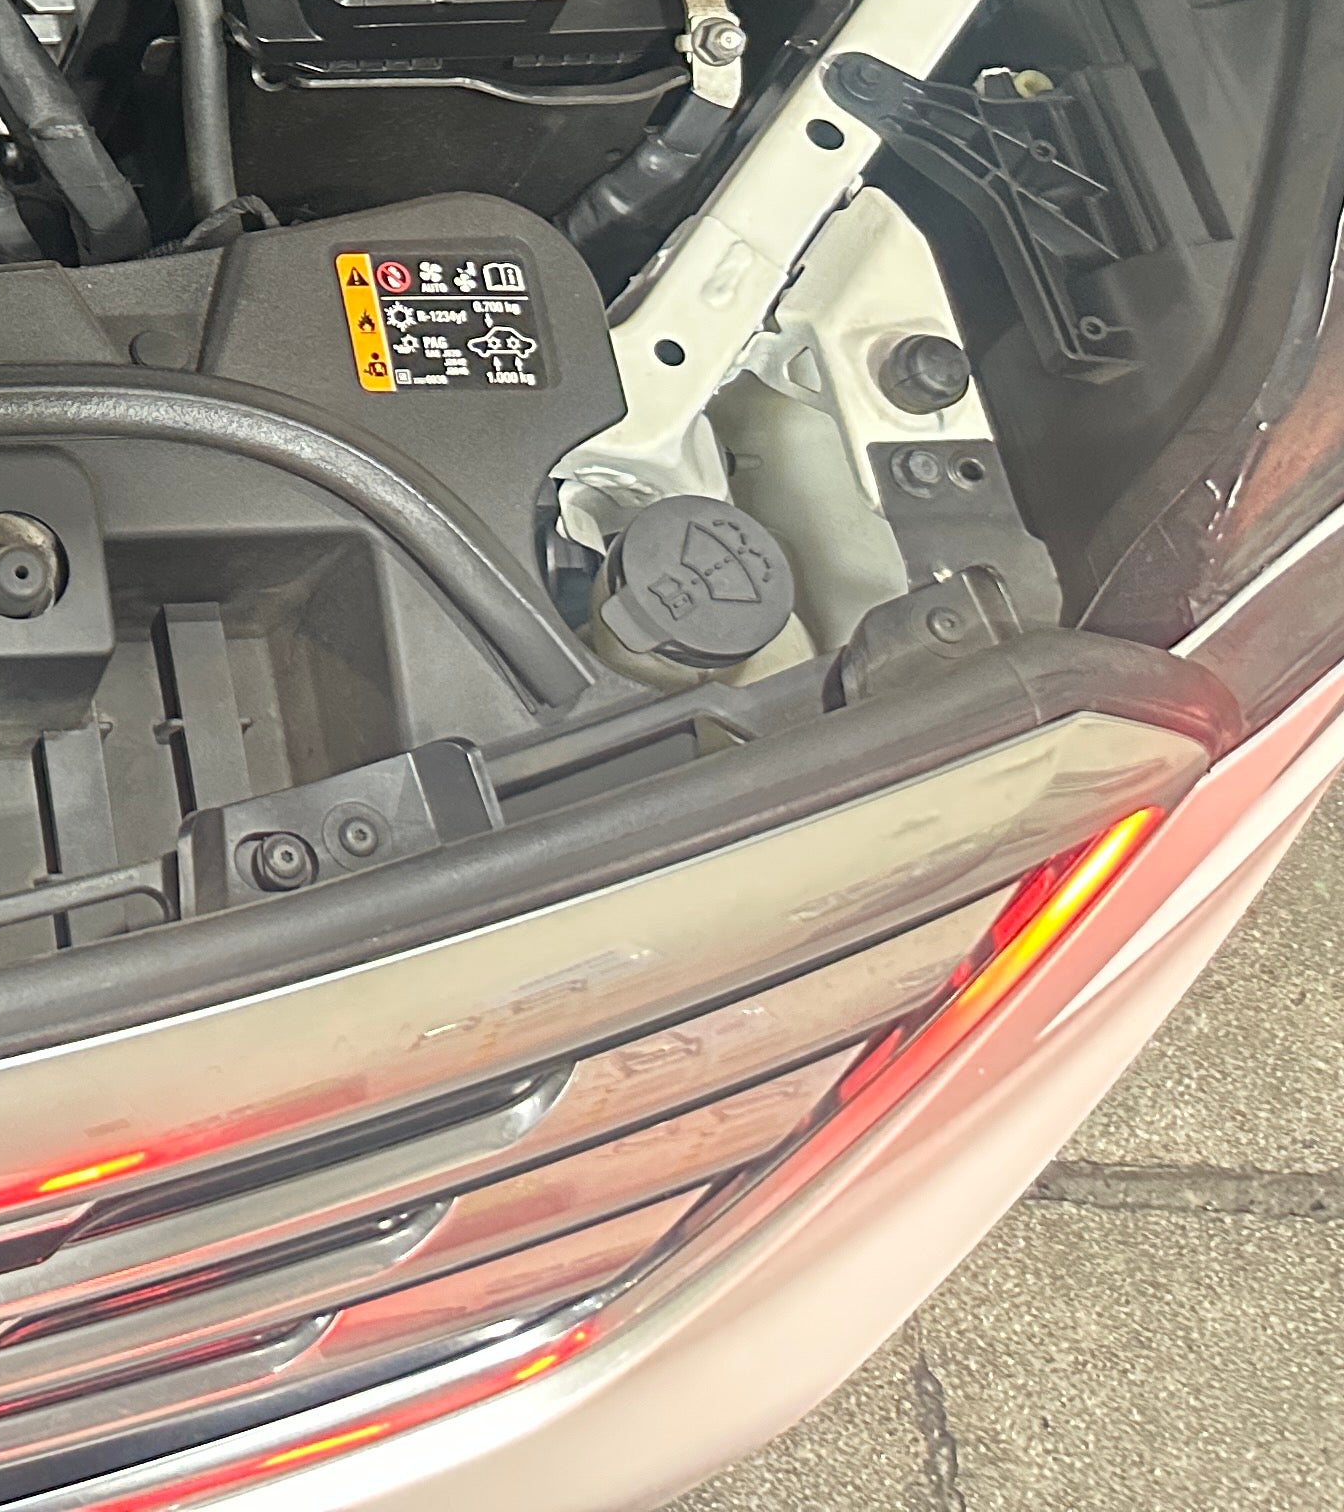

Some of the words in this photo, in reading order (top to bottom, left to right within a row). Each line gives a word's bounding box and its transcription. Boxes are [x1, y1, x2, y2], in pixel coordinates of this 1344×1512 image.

[421, 282, 448, 293] AUTO
[504, 301, 522, 316] kg
[422, 336, 449, 349] PAG
[486, 371, 518, 384] 1.000
[518, 372, 537, 386] kg
